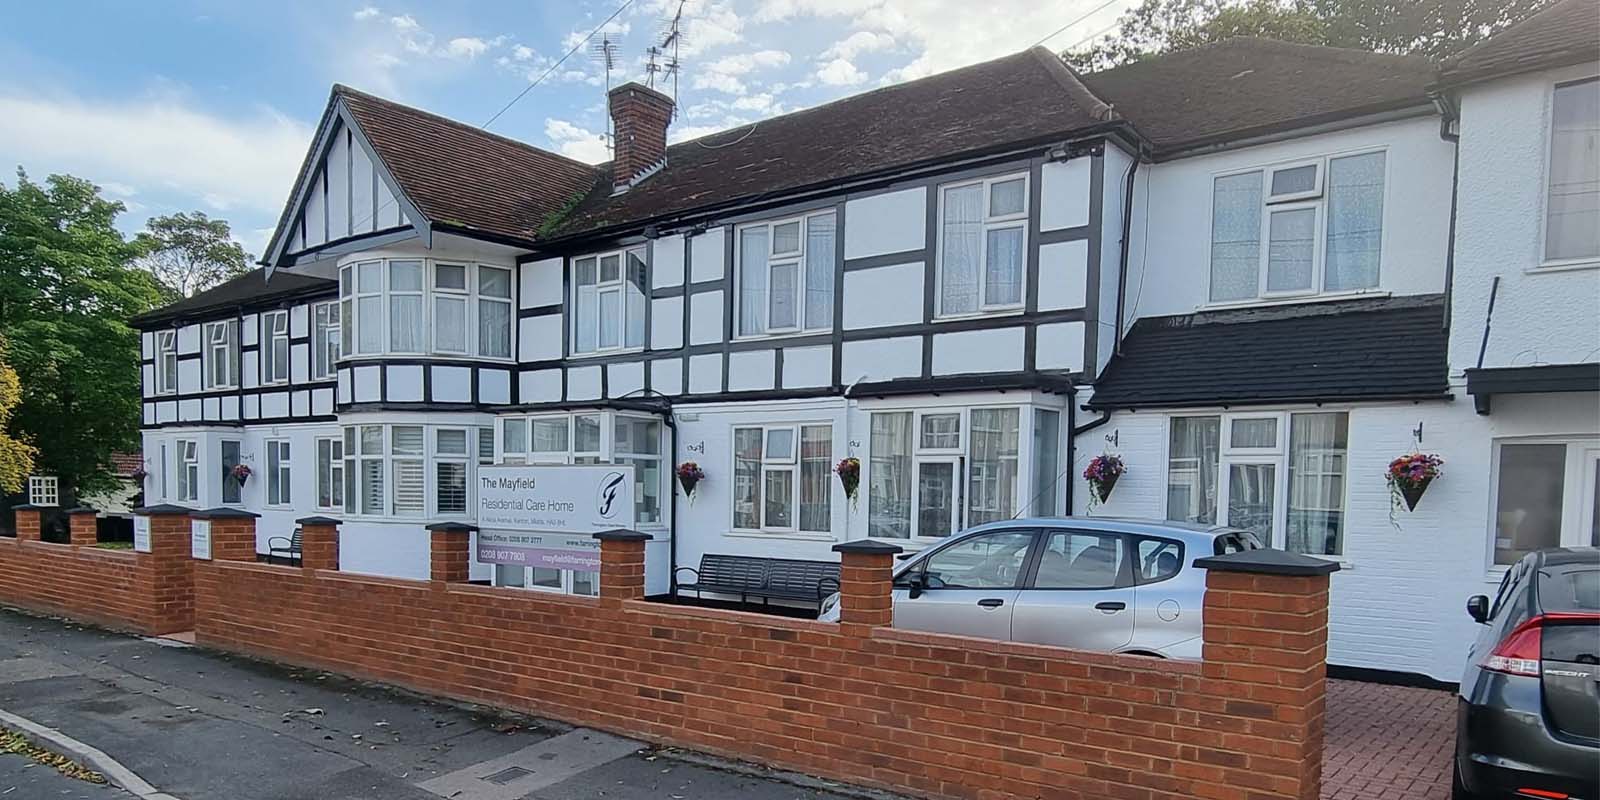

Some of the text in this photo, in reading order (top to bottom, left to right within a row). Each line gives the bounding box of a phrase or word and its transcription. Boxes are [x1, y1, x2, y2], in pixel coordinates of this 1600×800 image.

[481, 477, 536, 491] The Mayfield
[481, 498, 575, 512] Residential Care Home
[480, 549, 496, 559] 0208
[497, 550, 509, 560] 907
